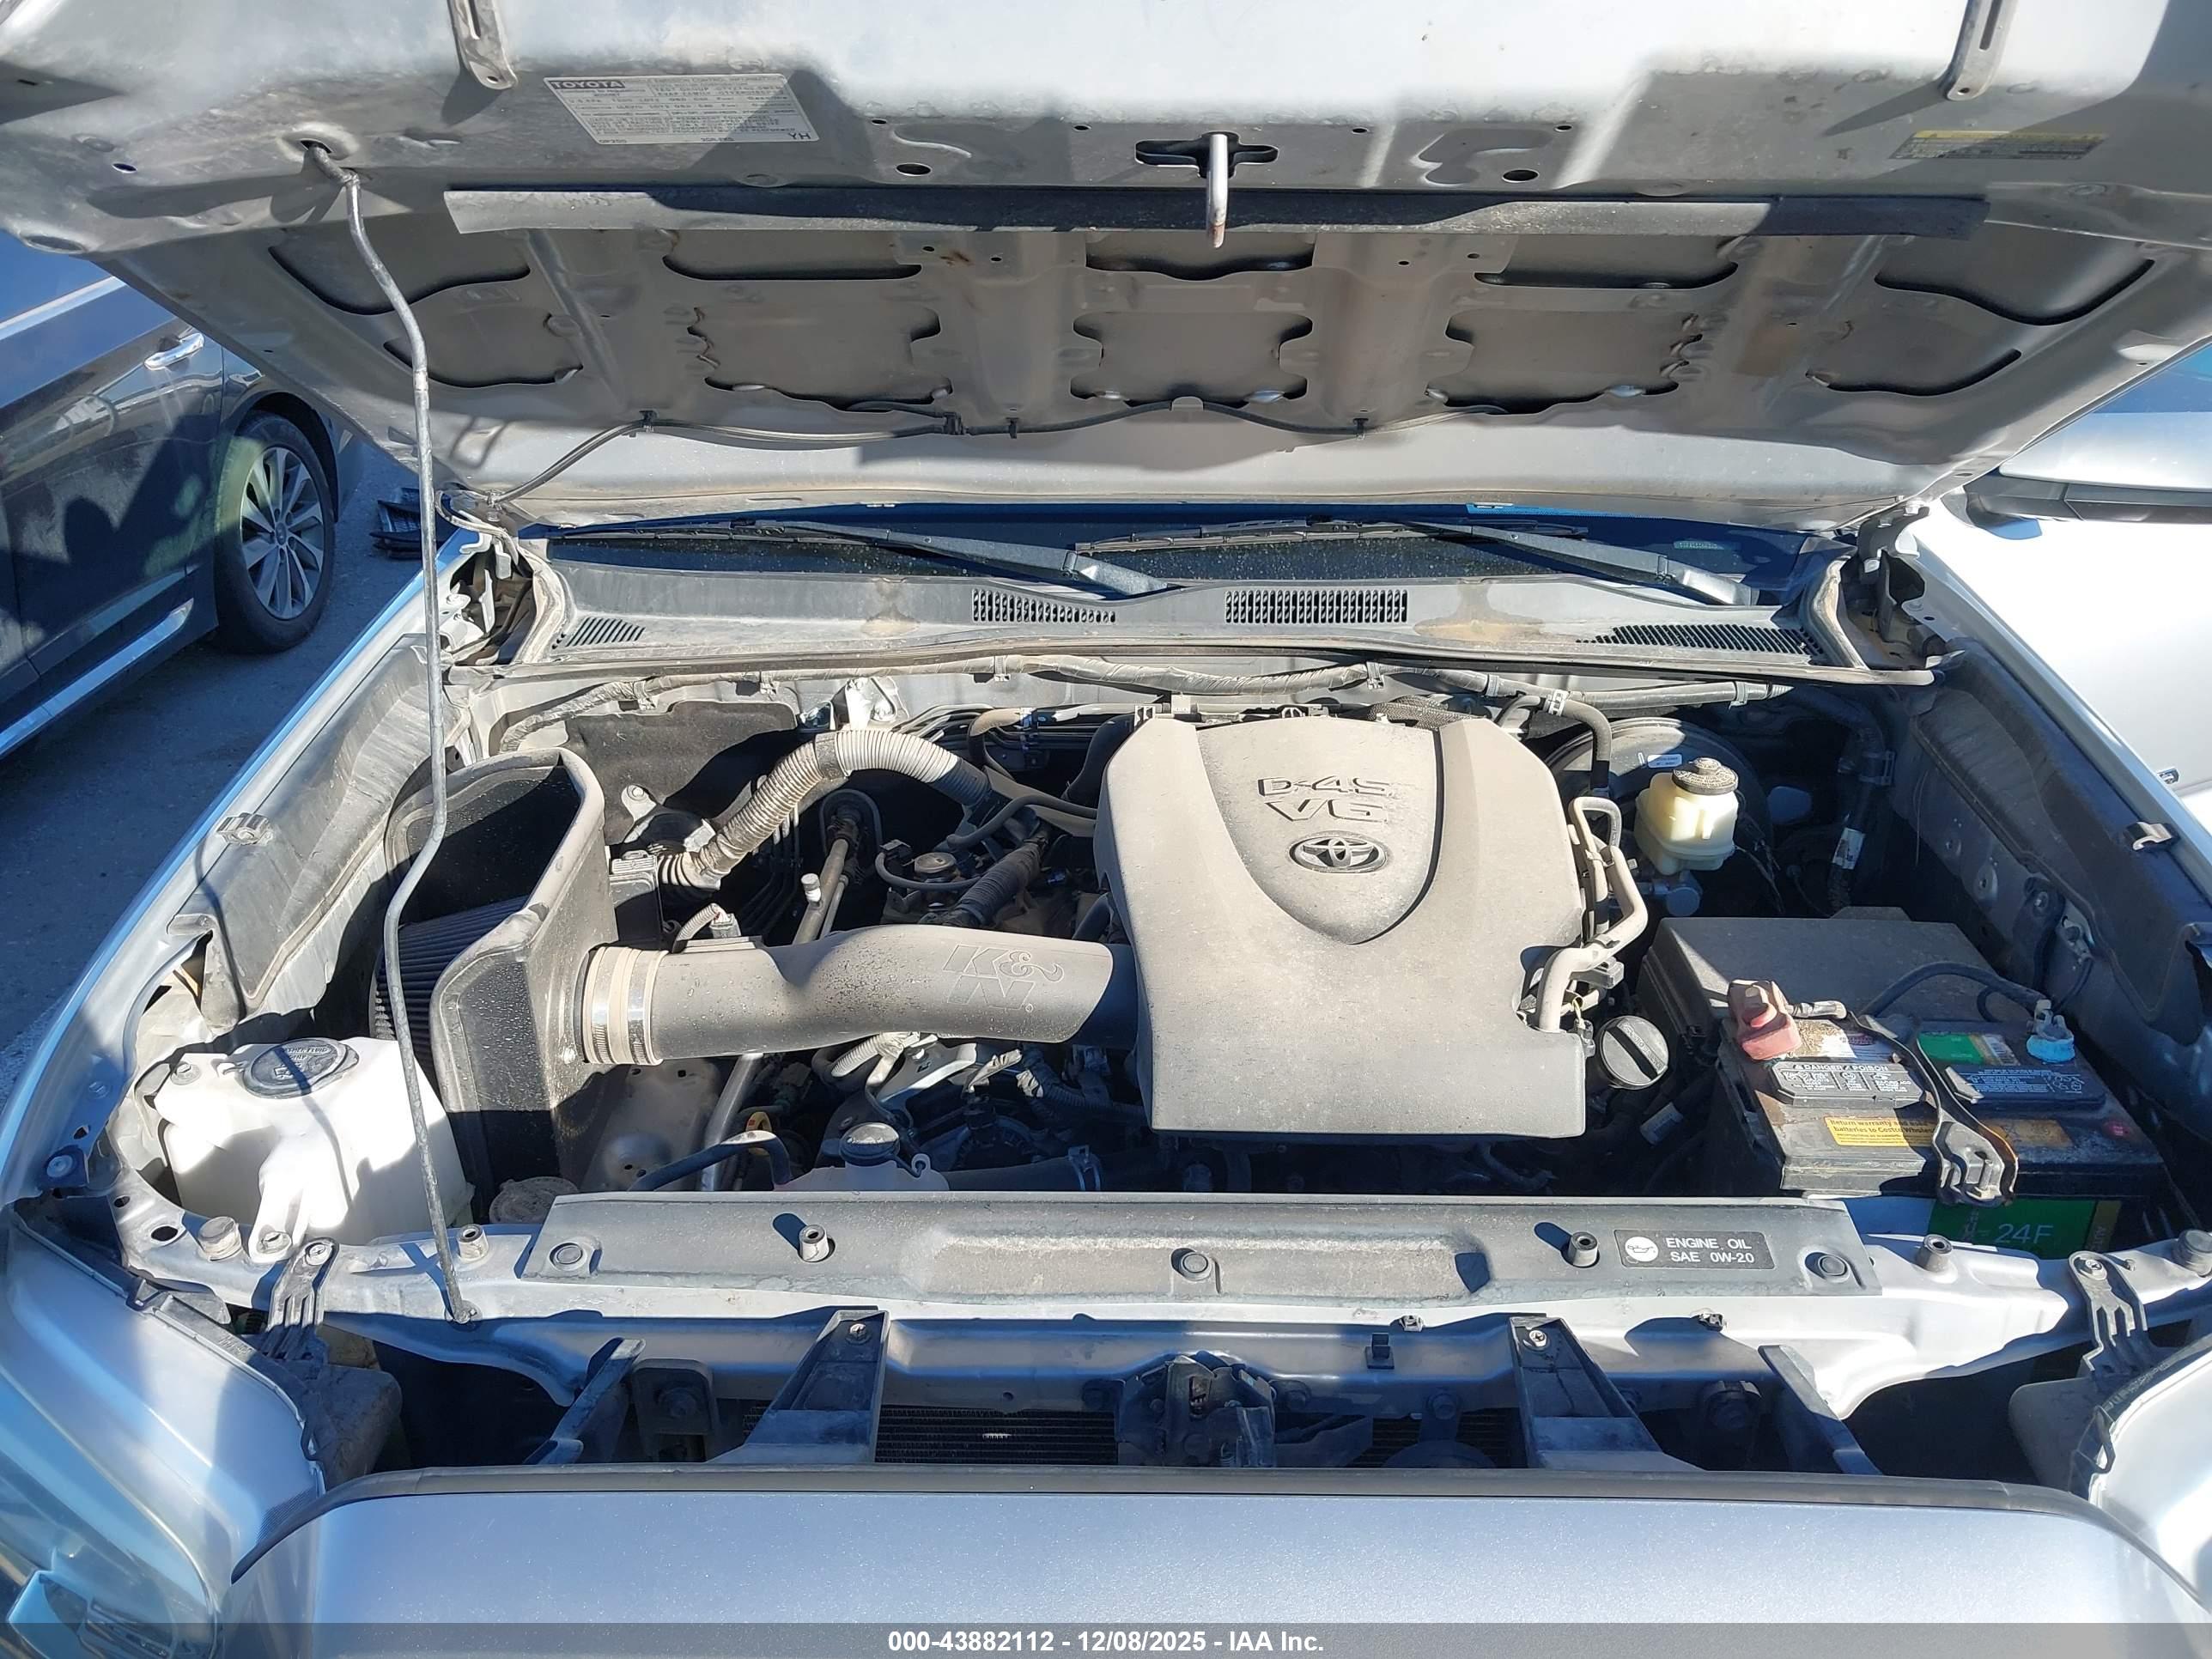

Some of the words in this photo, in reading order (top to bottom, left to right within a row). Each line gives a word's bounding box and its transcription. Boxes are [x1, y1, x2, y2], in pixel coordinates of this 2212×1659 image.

[552, 80, 623, 88] TOYOTA
[787, 131, 812, 140] YH
[1257, 775, 1391, 797] D-4S
[1264, 798, 1389, 823] V6
[1666, 1237, 1717, 1249] ENGINE
[1727, 1238, 1753, 1250] OIL
[1670, 1251, 1701, 1263] SAE
[1710, 1252, 1755, 1263] 0W-20
